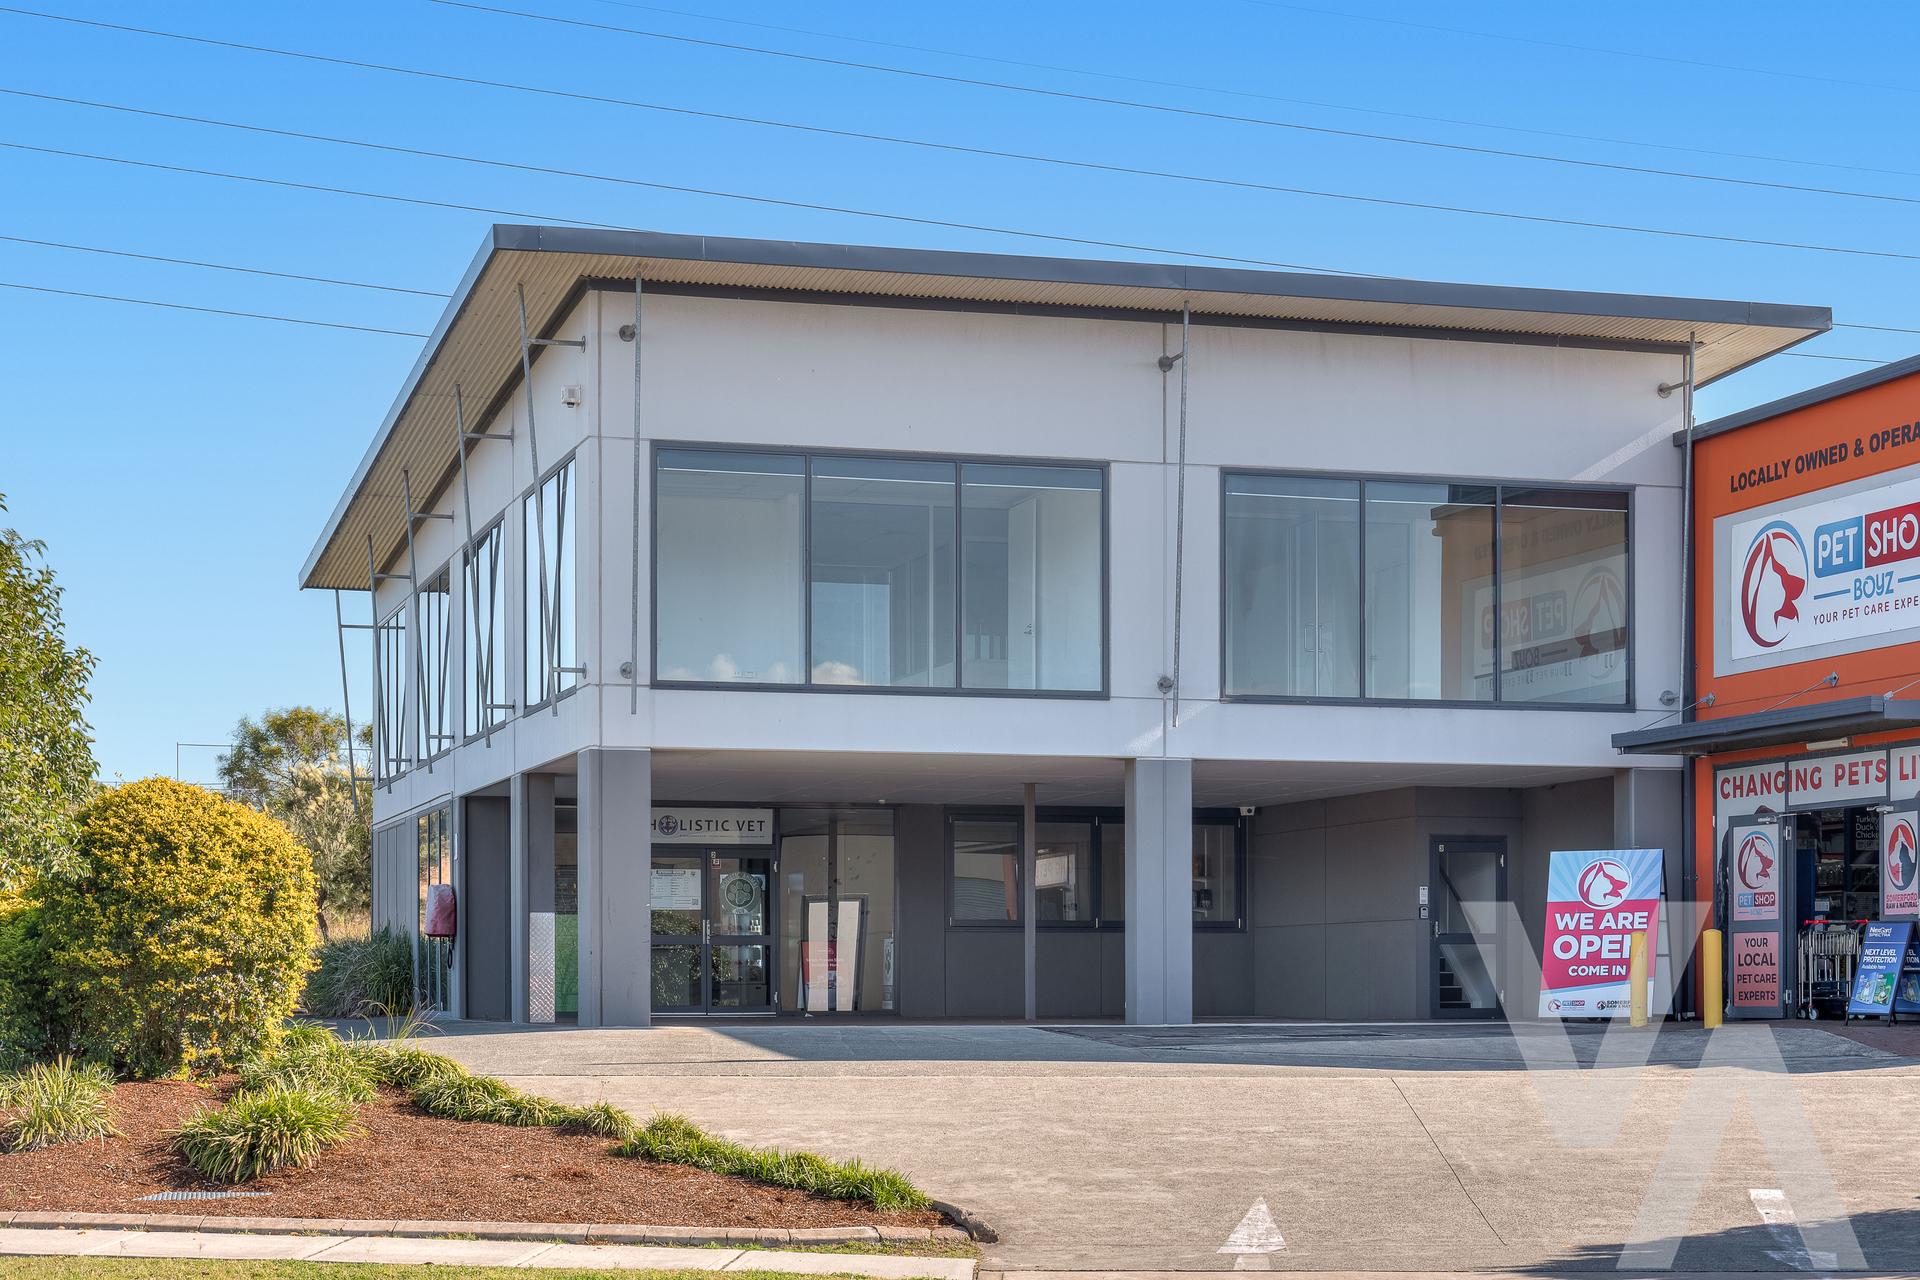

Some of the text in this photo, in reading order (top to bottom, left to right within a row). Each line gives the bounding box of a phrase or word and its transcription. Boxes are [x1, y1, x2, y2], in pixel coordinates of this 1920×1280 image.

[1730, 421, 1920, 493] LOCALLY OWNED & OPERA
[1818, 513, 1919, 569] PET SHO
[1853, 571, 1894, 600] BOYZ
[1814, 595, 1919, 625] YOUR PET CARE EXPE
[1720, 754, 1920, 800] CHANGING PETS LI
[736, 820, 766, 832] VET
[1739, 894, 1775, 906] PET SHOP
[1554, 911, 1649, 930] WE ARE
[1744, 938, 1768, 948] YOUR
[1738, 953, 1776, 967] LOCAL
[1862, 956, 1897, 964] PROTECTION
[1568, 965, 1626, 976] COME IN
[1737, 973, 1776, 984] PET CARE
[1738, 991, 1776, 1001] EXPERTS
